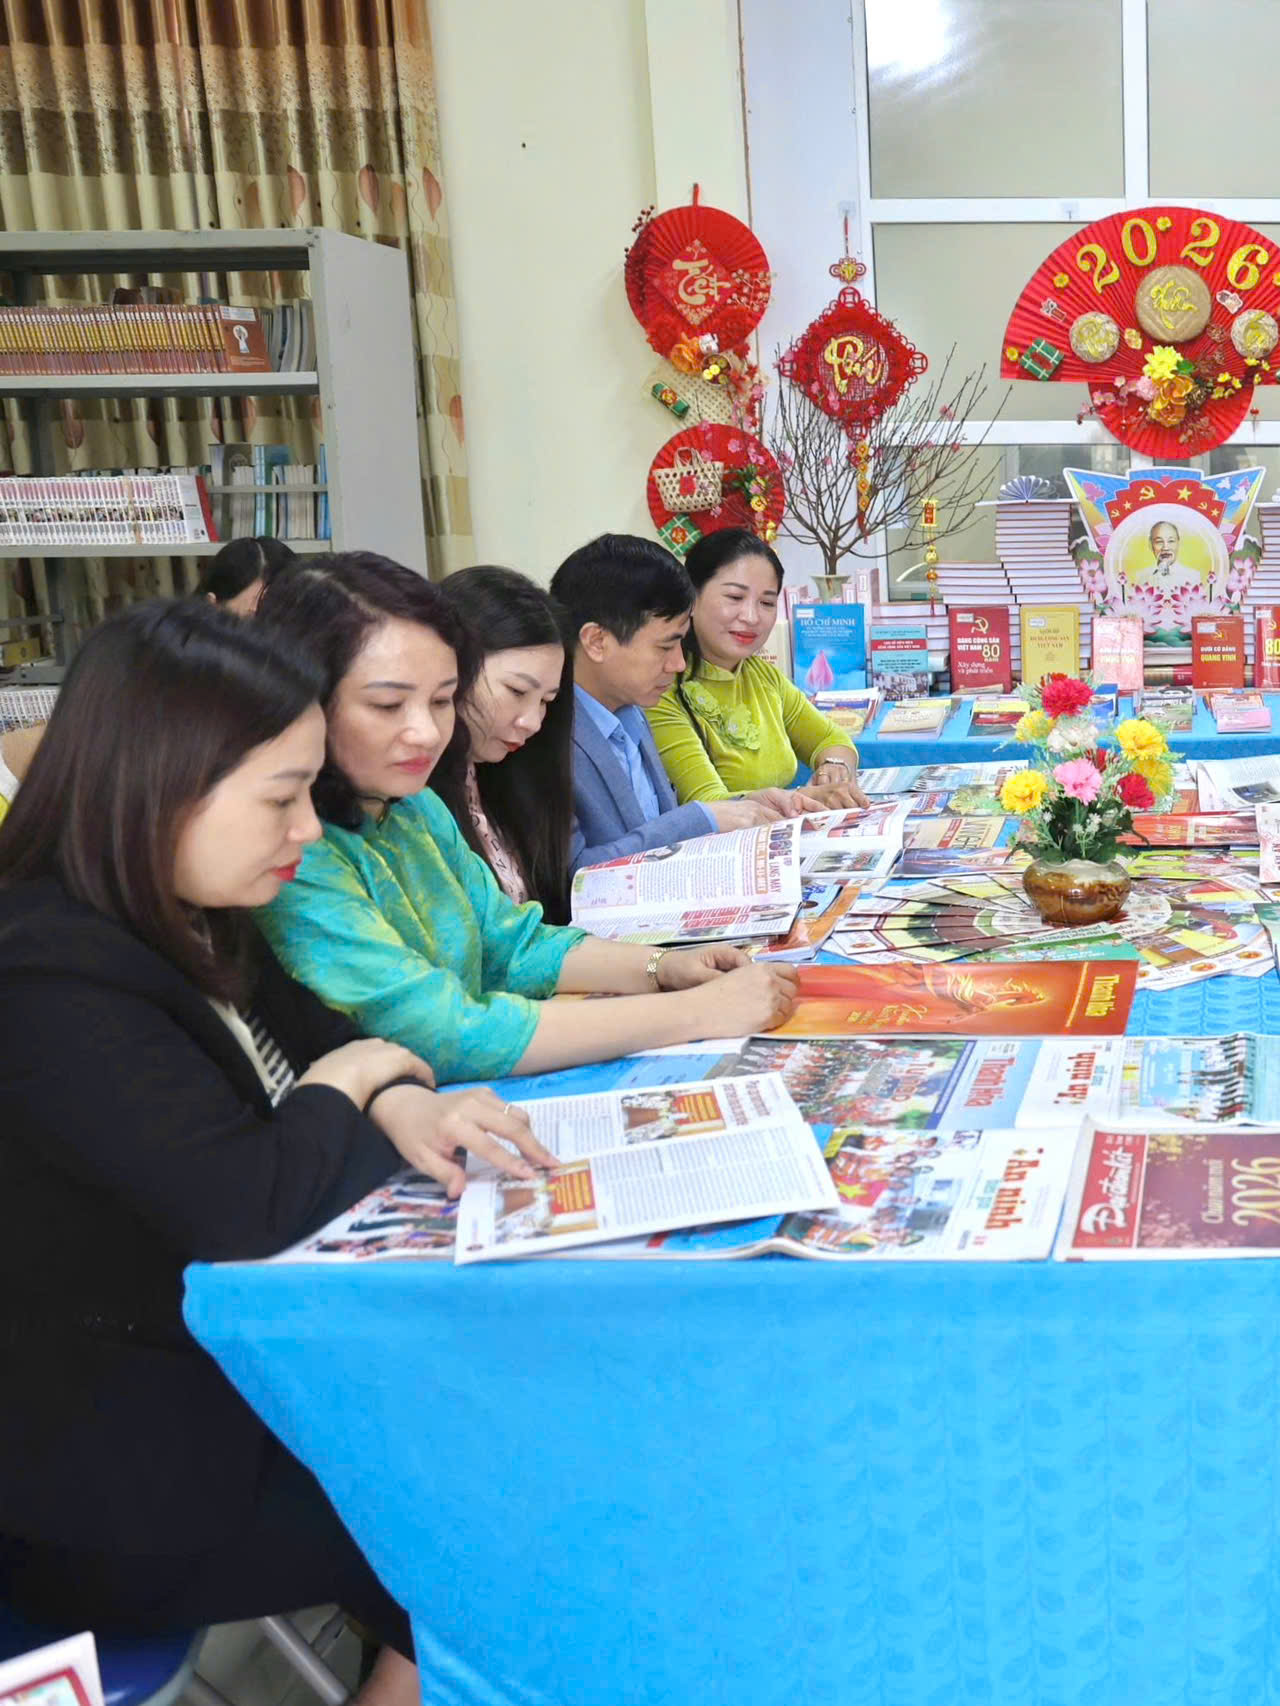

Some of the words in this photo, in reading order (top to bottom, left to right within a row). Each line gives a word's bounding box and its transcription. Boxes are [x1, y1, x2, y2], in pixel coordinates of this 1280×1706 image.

[672, 259, 731, 305] Tết
[982, 644, 1000, 658] 80
[1066, 1052, 1096, 1081] ninh
[1057, 1083, 1087, 1100] An
[1003, 1150, 1040, 1183] An
[984, 1186, 1026, 1230] ninh
